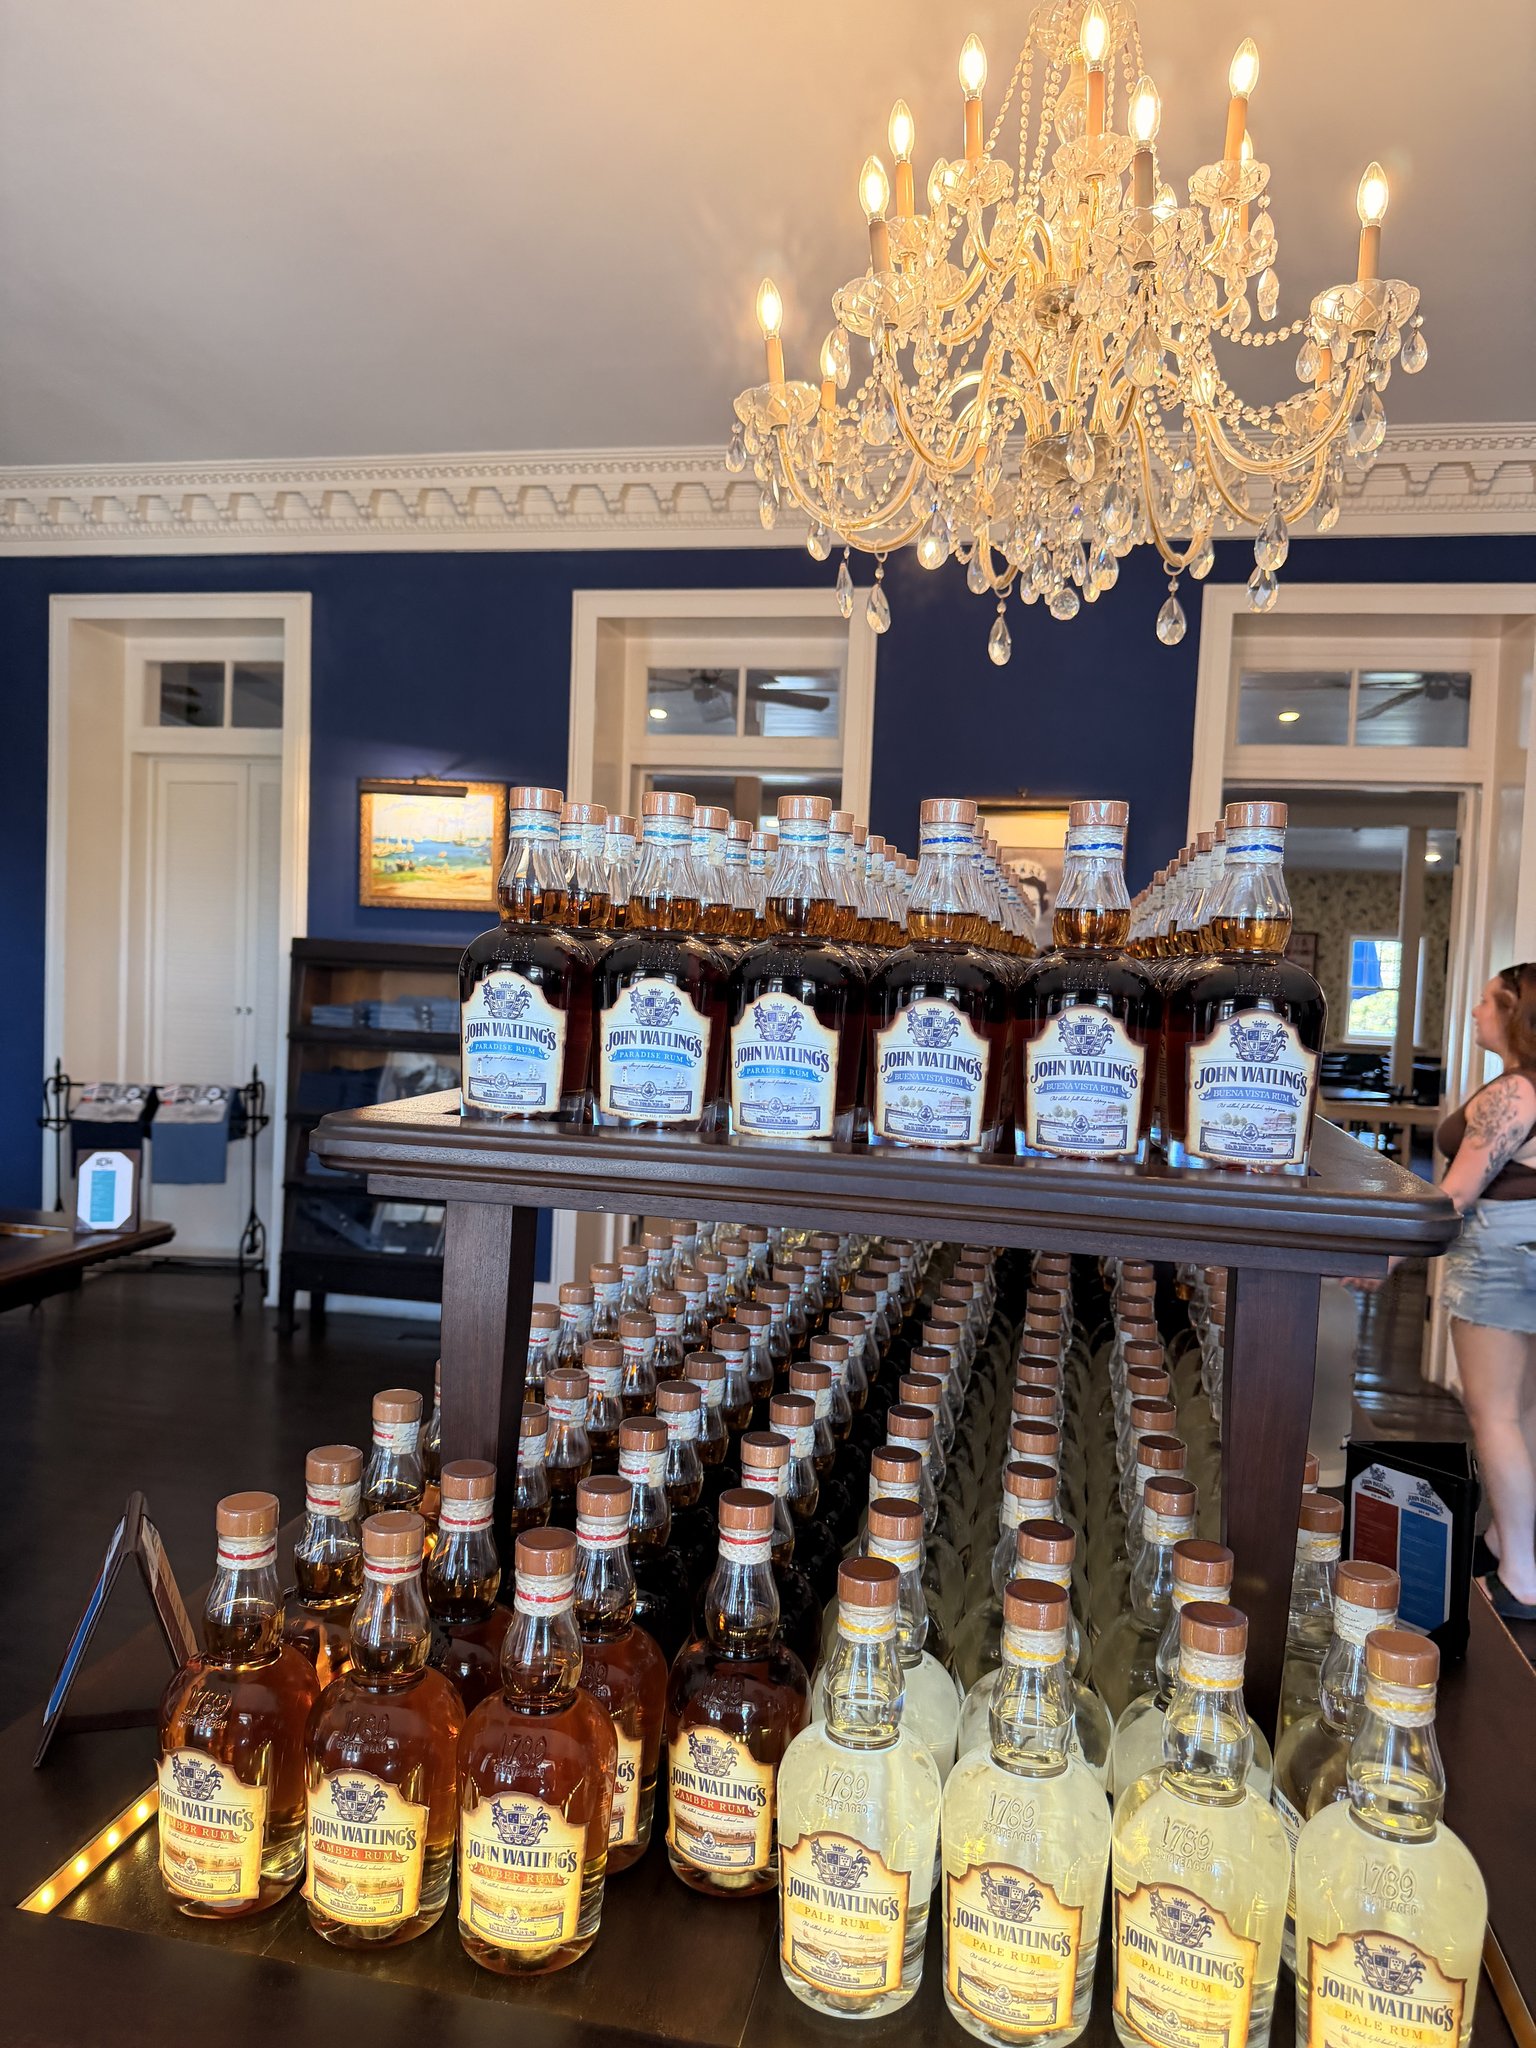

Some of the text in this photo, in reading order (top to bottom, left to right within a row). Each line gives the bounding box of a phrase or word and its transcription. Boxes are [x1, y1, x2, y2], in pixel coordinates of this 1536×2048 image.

[465, 1022, 557, 1050] JOHN WATLING'S
[475, 1043, 535, 1054] PARADISE RUM
[605, 1030, 702, 1058] JOHN WATLING'S
[619, 1051, 683, 1063] PARADISE RUM
[735, 1045, 830, 1073] JOHN WATLING'S
[881, 1051, 983, 1081] JOHN WATLING'S
[746, 1067, 809, 1078] PARADISE RUM
[895, 1073, 963, 1086] BUENA VISTA RUM
[1031, 1060, 1138, 1088] JOHN WATLING'S
[1194, 1066, 1308, 1097] JOHN WATLING'S
[1046, 1082, 1119, 1094] BUENA VISTA RUM
[1213, 1089, 1290, 1102] BUENA VISTA RUM
[670, 1767, 767, 1807] JOHN WATLING'S
[823, 1765, 869, 1803] 1789
[181, 1800, 254, 1832] WATLING'S
[680, 1794, 714, 1808] AMBER
[719, 1802, 746, 1814] RUM
[988, 1790, 1036, 1832] 1789
[168, 1817, 196, 1834] MBER
[202, 1827, 231, 1840] RUM
[310, 1816, 417, 1851] JOHN WATLING'S
[1161, 1816, 1214, 1861] 1789
[320, 1844, 394, 1861] AMBER RUM
[466, 1839, 577, 1873] JOHN WATLING'S
[479, 1866, 557, 1884] AMBER RUM
[1361, 1855, 1417, 1902] 1789
[787, 1876, 899, 1921] JOHN WATLING'S
[804, 1908, 870, 1930] PALE RUM
[953, 1907, 1071, 1957] JOHN WATLING'S
[972, 1939, 1041, 1965] PALE RUM
[1122, 1925, 1245, 1989] JOHN WATLING'S
[1141, 1959, 1212, 1994] PALE RUM
[1317, 1976, 1454, 2032] JOHN WATLING'S
[1344, 2009, 1424, 2040] PALE RUM
